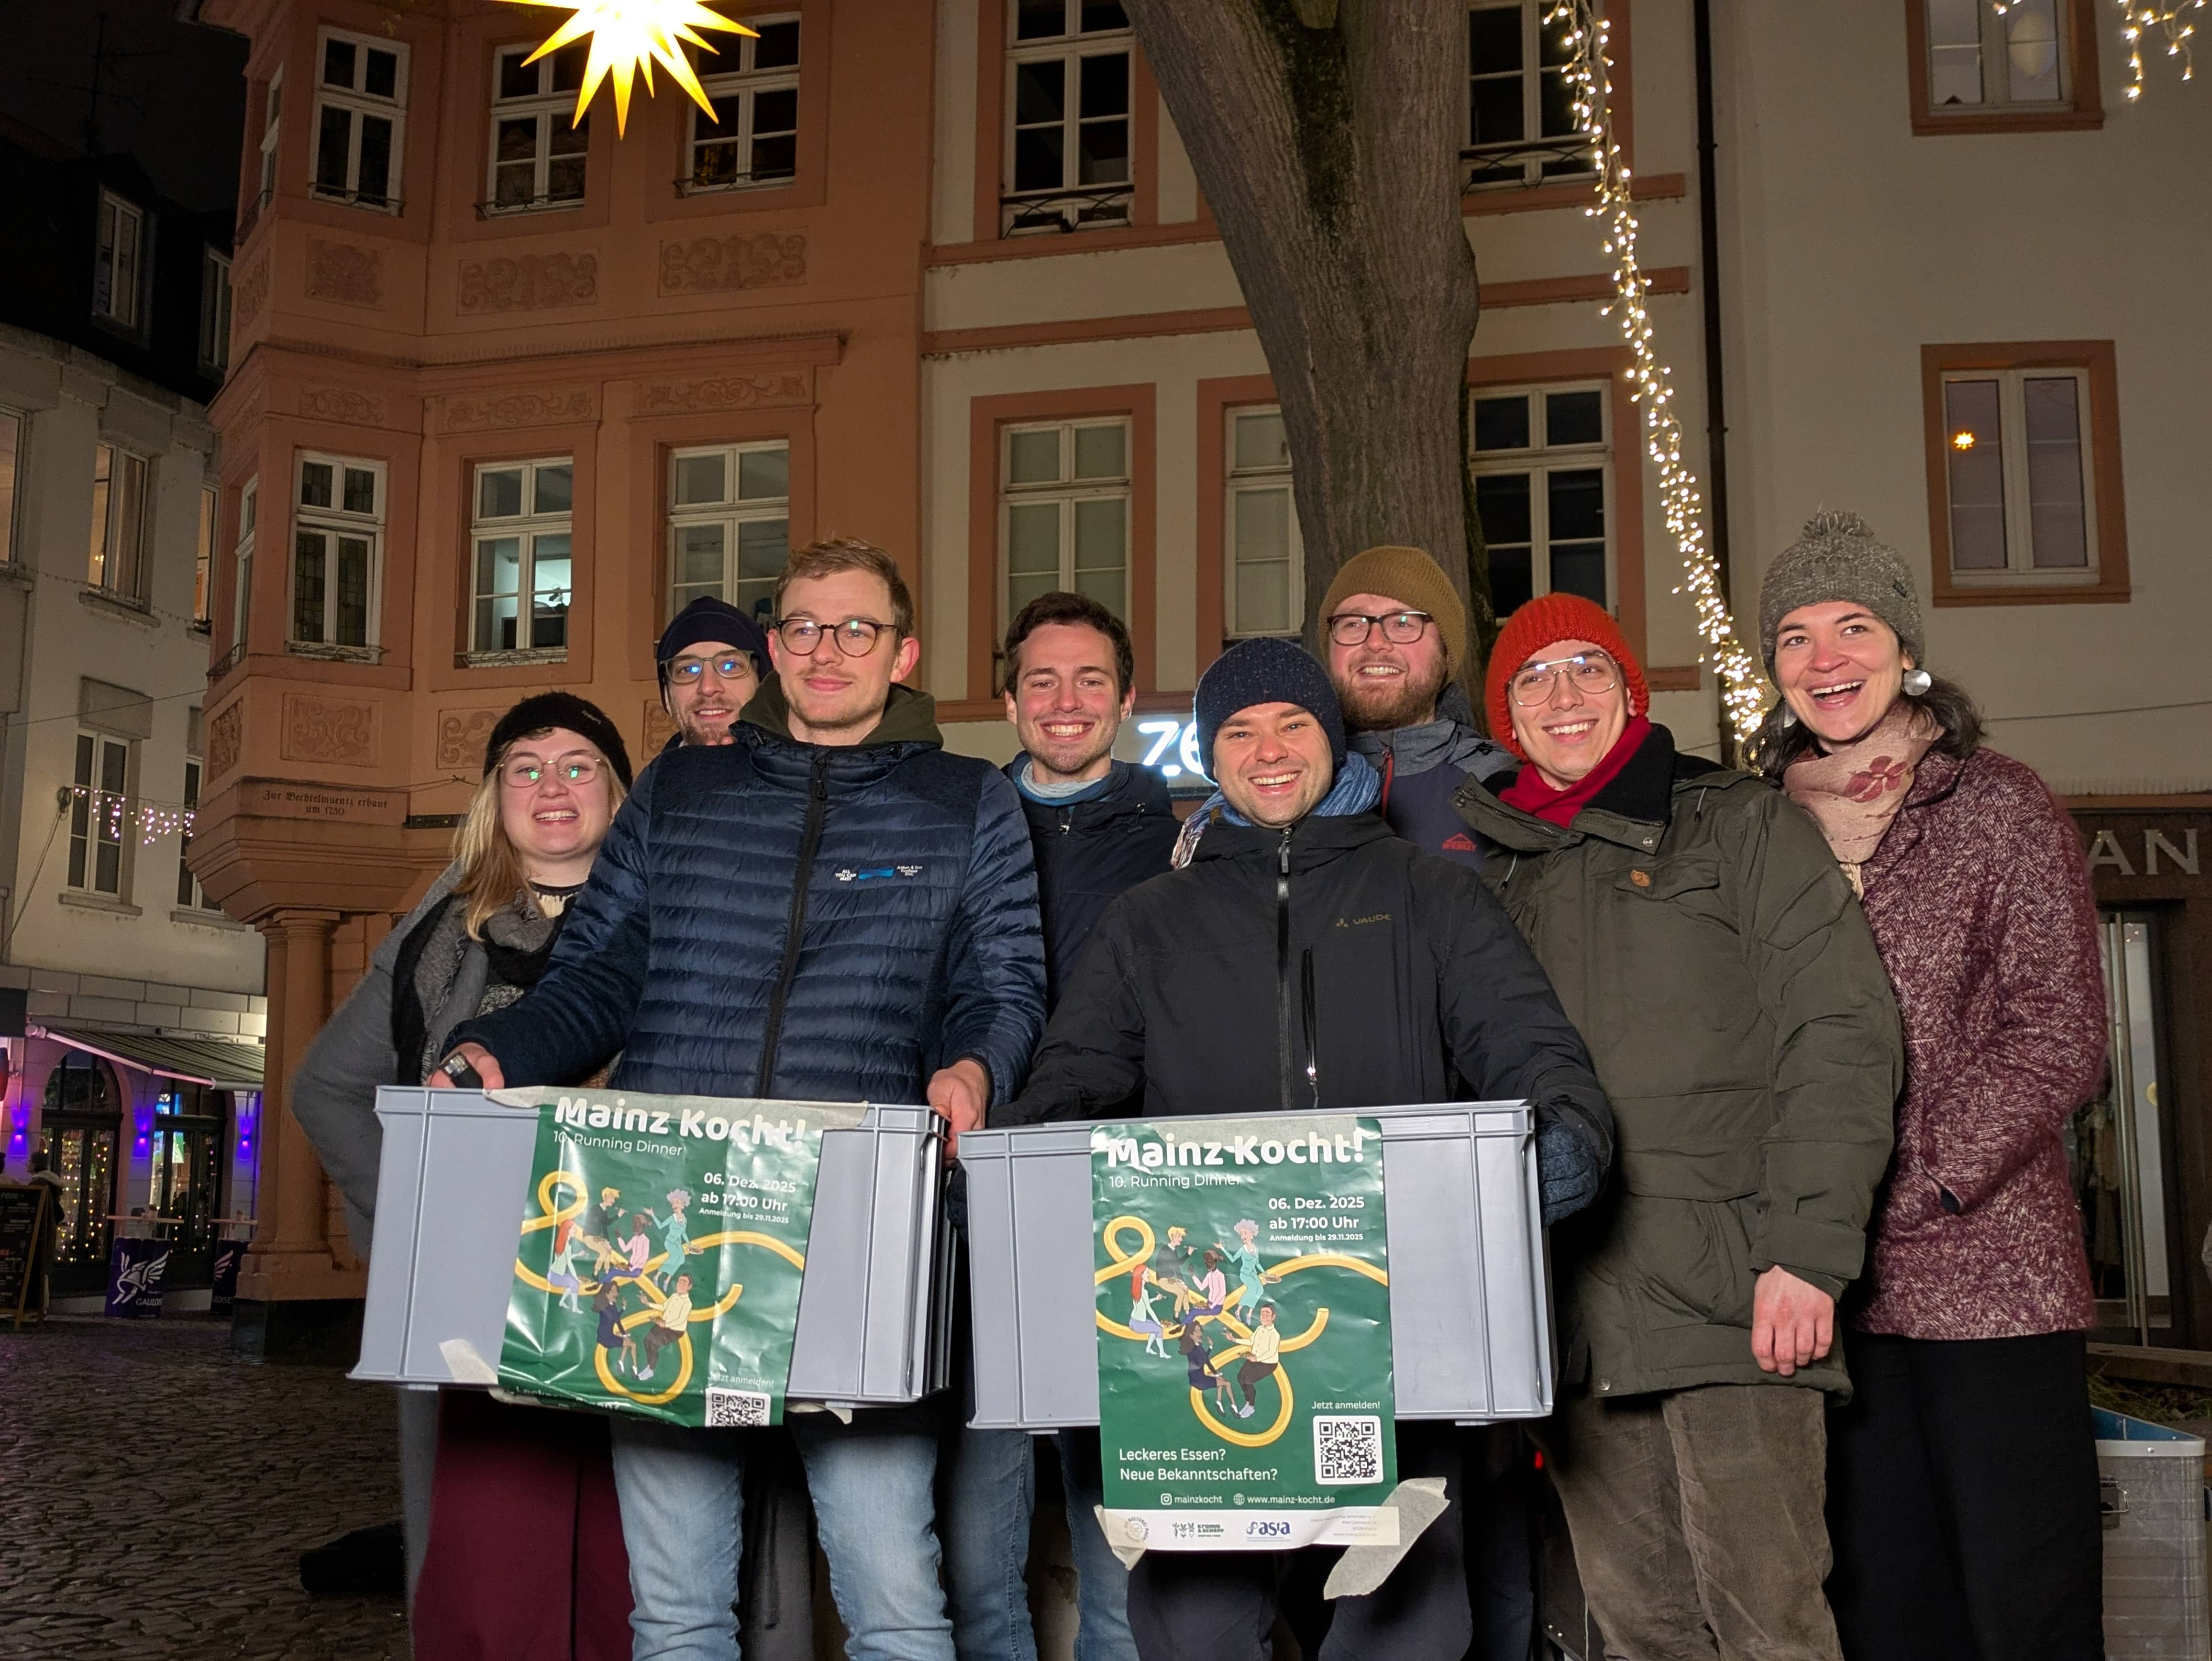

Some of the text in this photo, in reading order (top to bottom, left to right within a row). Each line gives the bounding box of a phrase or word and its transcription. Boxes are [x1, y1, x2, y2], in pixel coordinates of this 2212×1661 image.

[263, 790, 281, 800] Zur
[358, 798, 387, 808] erbaut
[554, 1096, 807, 1149] Mainz Kocht!
[574, 1134, 632, 1152] Running
[637, 1141, 683, 1156] Dinner
[1107, 1132, 1364, 1167] Mainz Kocht!
[704, 1172, 796, 1193] 06. Dez. 2025
[1109, 1174, 1241, 1189] 10. Running Dinner
[701, 1193, 787, 1212] ab 17:00 Uhr
[1268, 1196, 1365, 1210] 06. Dez. 2025
[699, 1208, 741, 1220] Anmeldung
[755, 1214, 789, 1224] 29.11.2025
[1269, 1217, 1359, 1229] ab 17:00 Uhr
[1269, 1234, 1313, 1242] Anmeldung
[730, 1376, 774, 1388] anmelden!
[1335, 1401, 1381, 1409] anmelden!
[1119, 1449, 1226, 1461] Leckeres Essen?
[1120, 1468, 1278, 1481] Neue Bekanntschaften?
[1174, 1495, 1335, 1504] mainzkocht www.mainz-kocht.de
